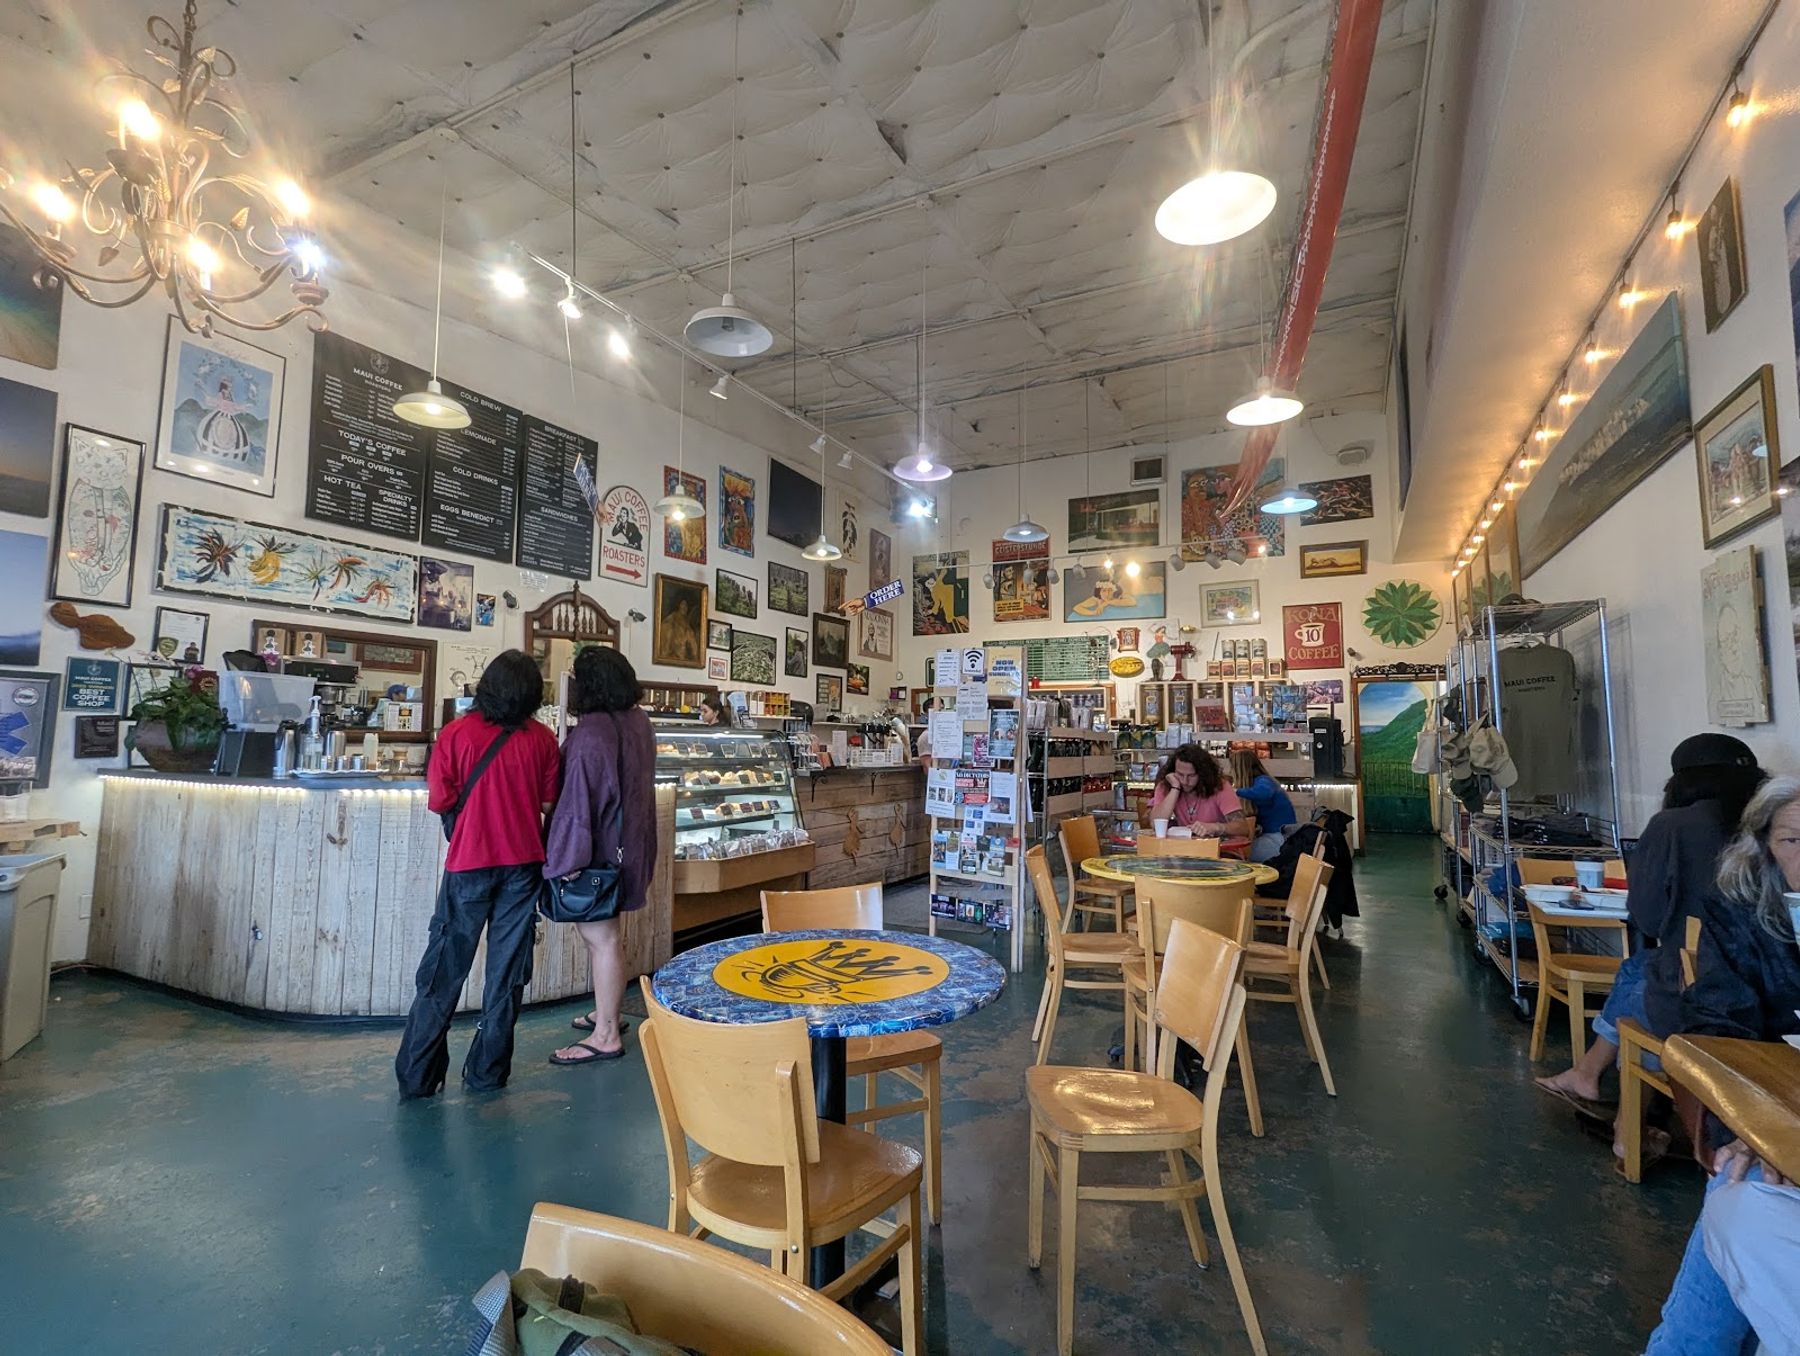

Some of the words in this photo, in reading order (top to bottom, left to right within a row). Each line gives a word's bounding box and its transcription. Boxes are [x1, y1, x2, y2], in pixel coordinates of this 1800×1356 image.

[353, 368, 373, 379] MAUI
[374, 375, 402, 391] COFFEE
[460, 391, 479, 403] COLD
[480, 399, 502, 412] BREW
[338, 429, 374, 446] TODAY'S
[375, 441, 407, 457] COFFEE
[460, 428, 497, 446] LEMONADE
[544, 425, 578, 443] BREAKFAST
[340, 454, 366, 467] POUR
[367, 461, 395, 475] OVERS
[323, 475, 344, 486] HOT
[345, 480, 363, 491] TEA
[452, 466, 472, 477] COLD
[473, 472, 499, 486] DRINKS
[378, 489, 413, 503] SPECIALTY
[382, 496, 408, 508] DRINKS
[440, 503, 460, 515] EGGS
[461, 509, 495, 524] BENEDICT
[540, 506, 579, 522] SANDWICHES
[607, 491, 623, 523] MAUI
[624, 490, 649, 532] COFFEE
[603, 545, 646, 568] ROASTERS
[870, 580, 901, 599] ORDER
[875, 588, 901, 605] HERE
[1288, 643, 1340, 661] COFFEE
[1503, 679, 1525, 689] MAUI
[1526, 675, 1557, 685] COFFEE
[72, 694, 111, 702] COFFEE
